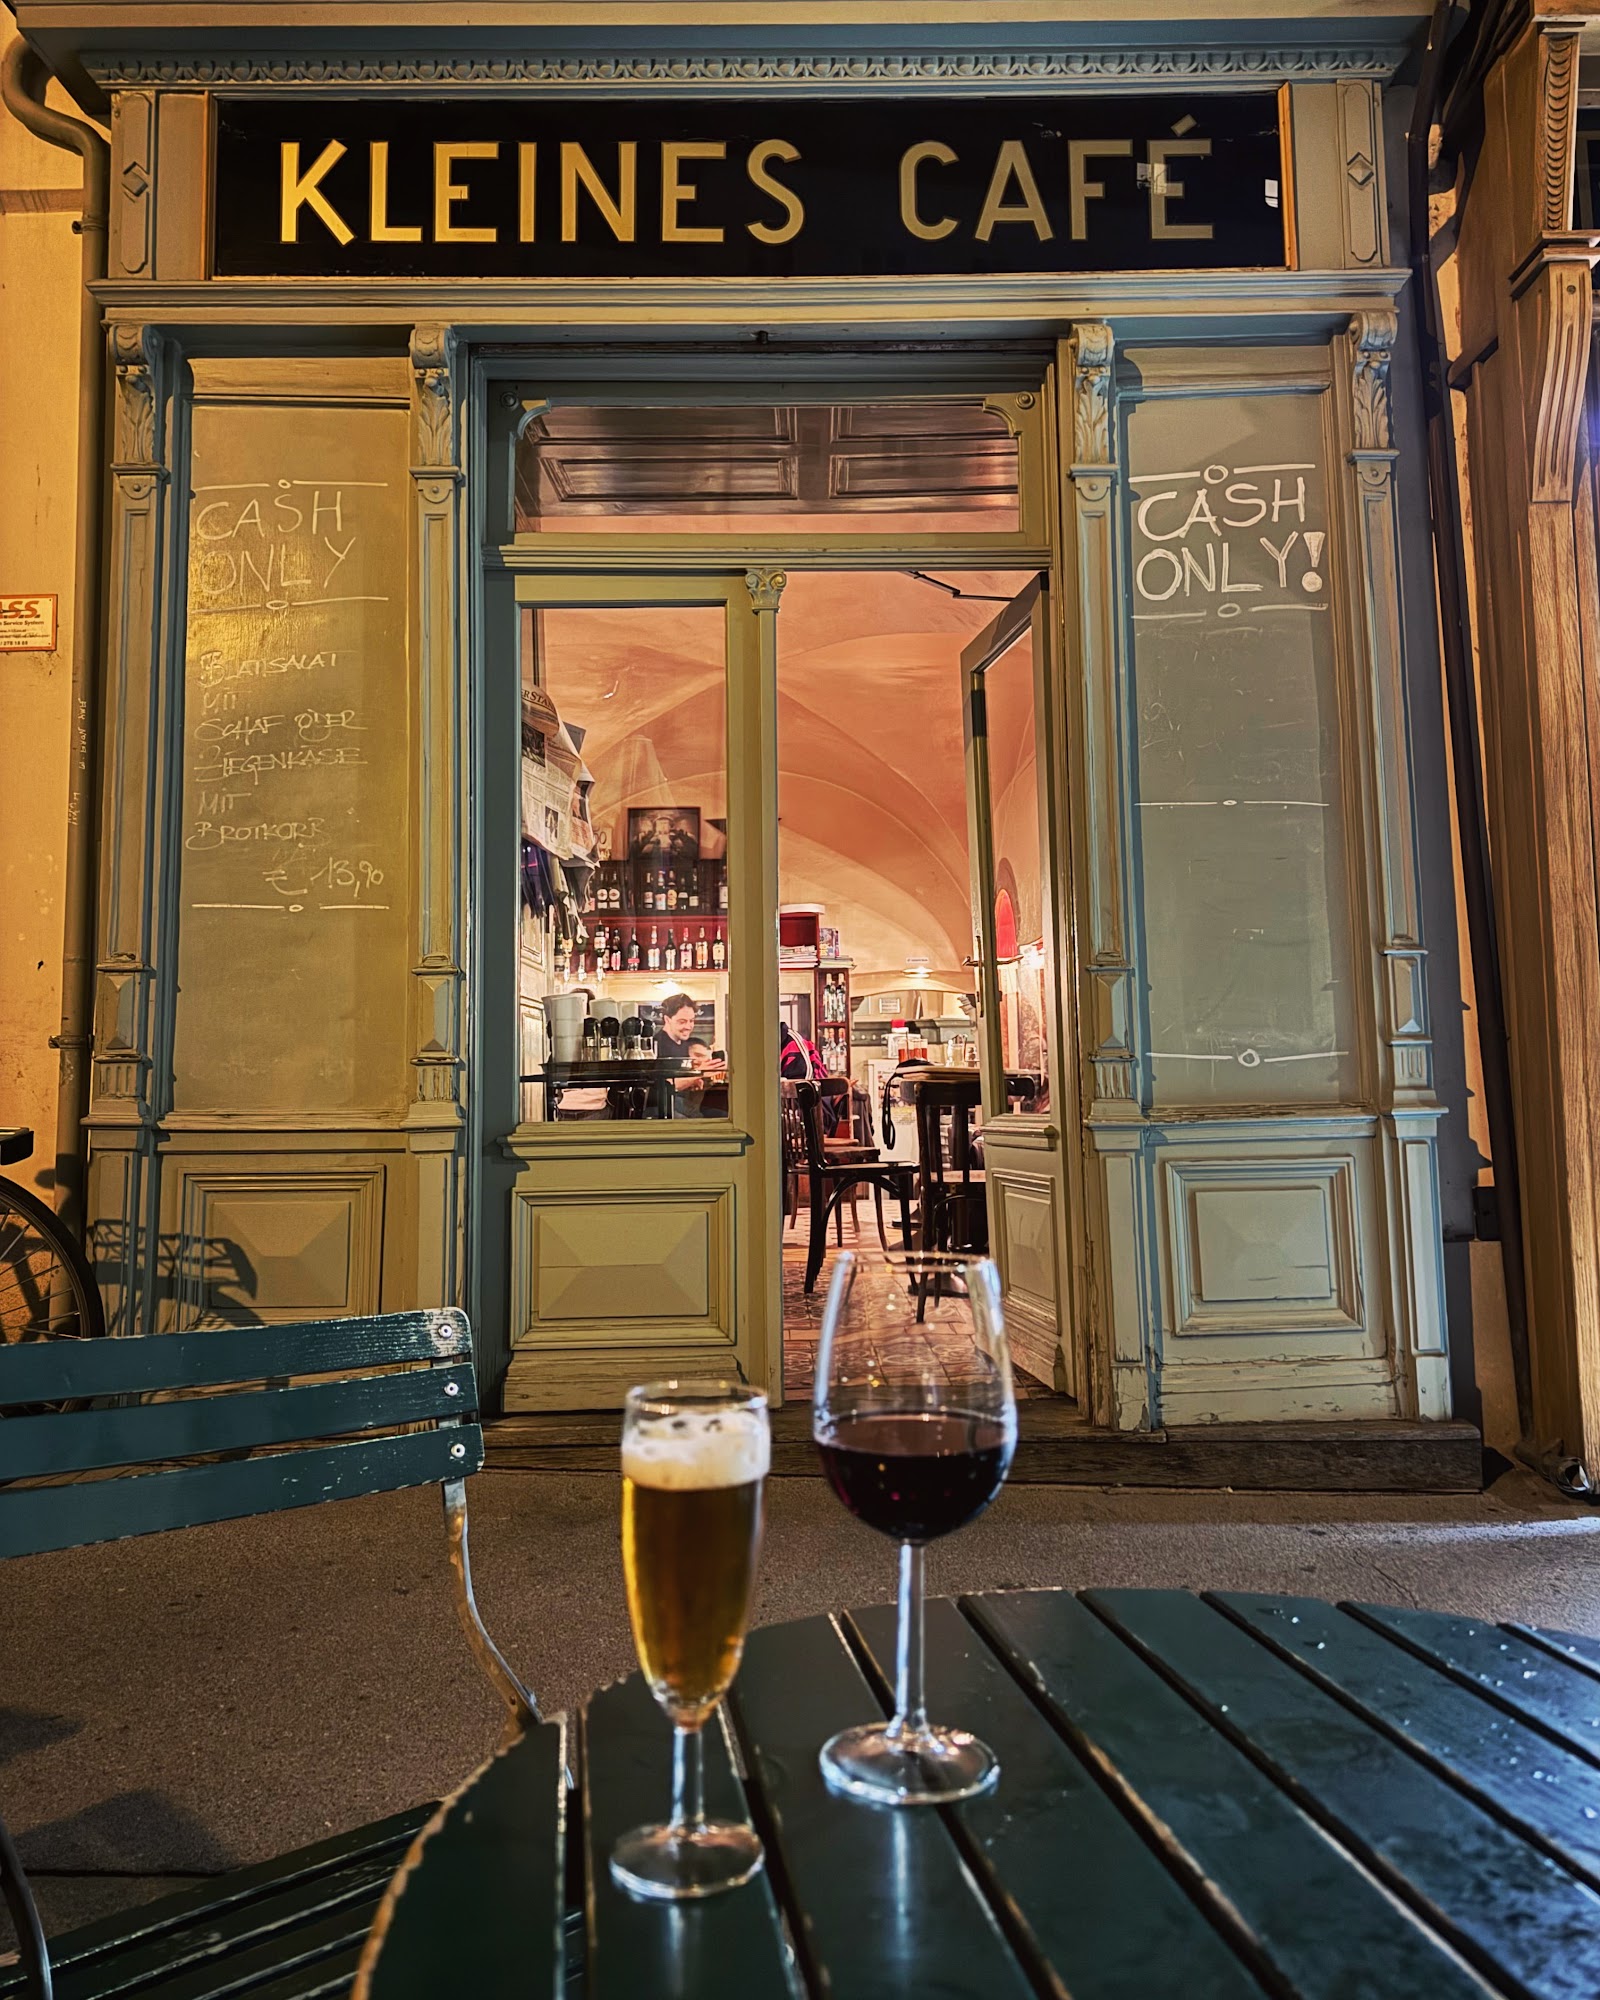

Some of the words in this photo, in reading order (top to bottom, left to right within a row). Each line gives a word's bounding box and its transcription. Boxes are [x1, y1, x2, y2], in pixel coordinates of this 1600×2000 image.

[280, 138, 804, 245] KLEINES
[899, 114, 1213, 243] CAFÉ
[197, 491, 342, 540] CASH
[1137, 477, 1305, 541] CASH
[200, 537, 356, 596] ONLY
[1136, 531, 1325, 600] ONLY!
[194, 714, 285, 746] SCHAF
